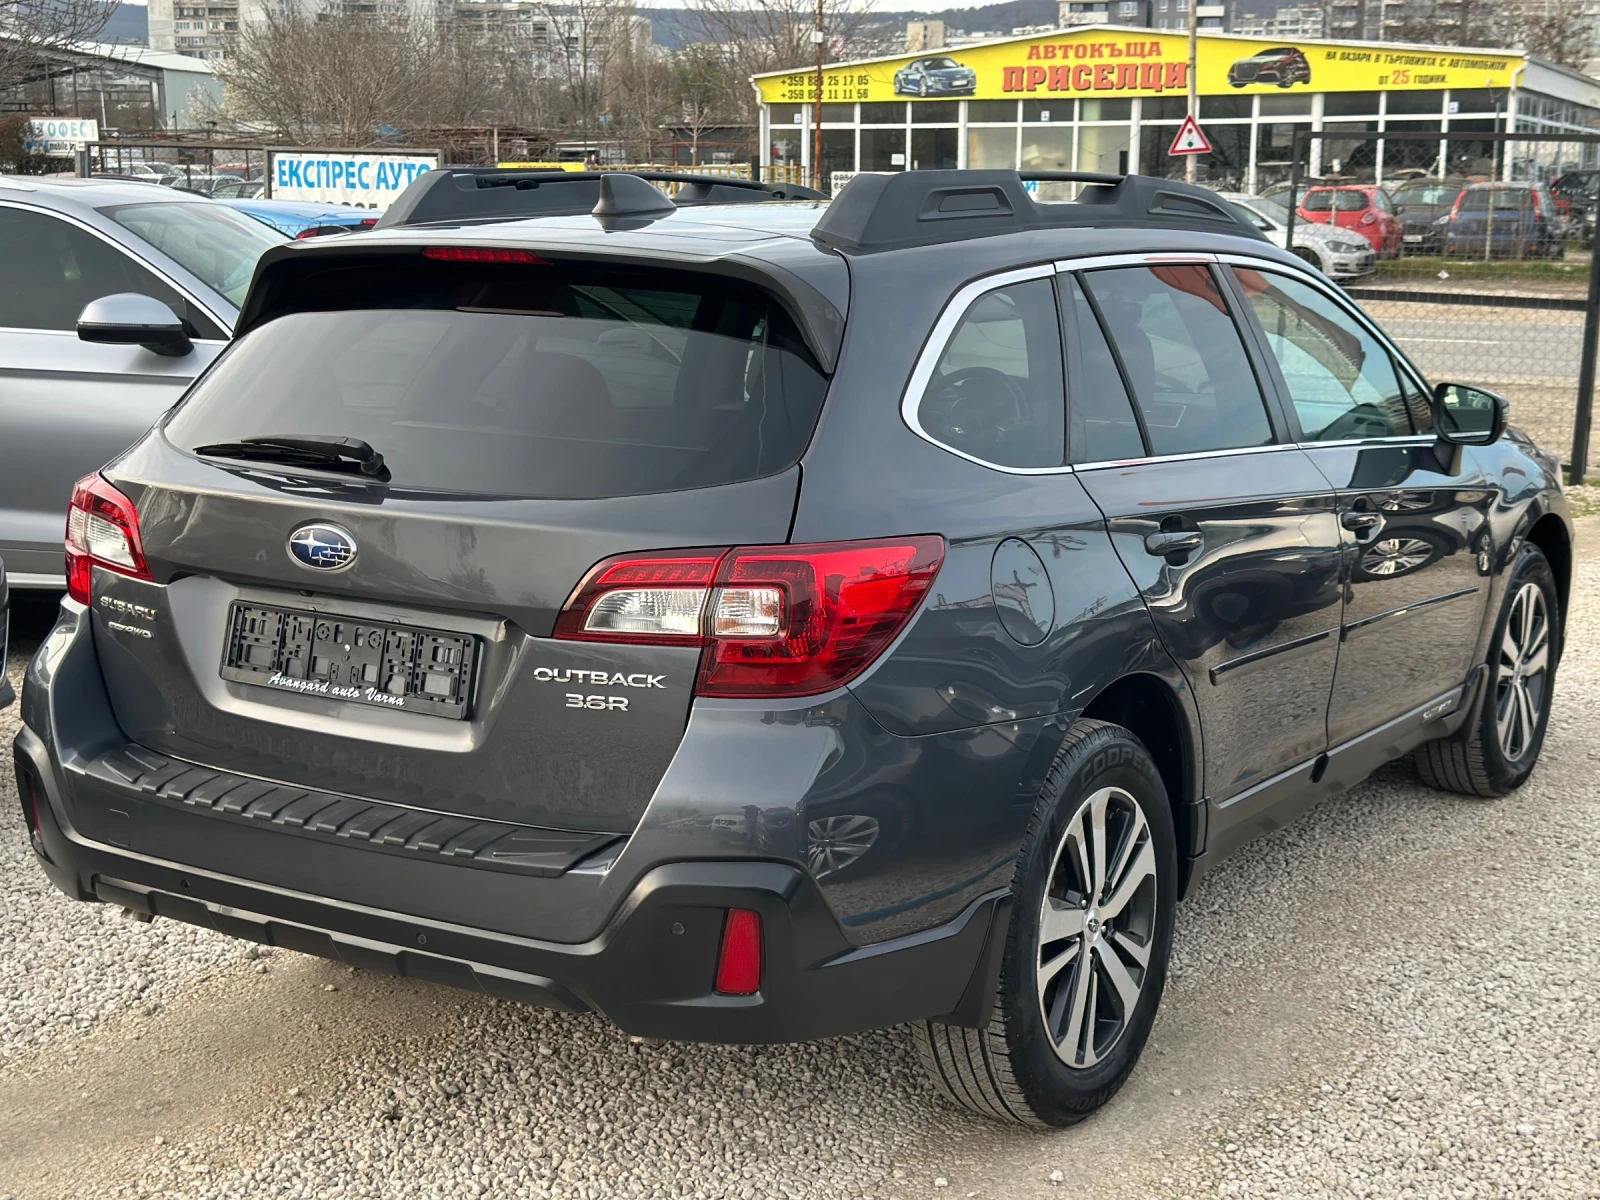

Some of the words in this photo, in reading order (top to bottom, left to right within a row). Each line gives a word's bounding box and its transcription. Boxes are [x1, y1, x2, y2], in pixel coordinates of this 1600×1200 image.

[1027, 42, 1162, 60] АВТОКЪЩА
[781, 76, 804, 86] +359
[828, 75, 839, 86] 25
[843, 75, 854, 86] 17
[857, 75, 869, 85] 05
[1002, 62, 1191, 93] ПРИСЕЛЦИ
[1392, 69, 1411, 85] 25
[781, 90, 804, 99] +359
[828, 89, 839, 99] 11
[842, 89, 853, 99] 11
[857, 88, 869, 99] 56
[277, 160, 370, 190] ЕКСПРЕС
[100, 595, 158, 621] SUBARU
[533, 667, 668, 688] OUTBACK
[565, 693, 629, 711] 3.6R
